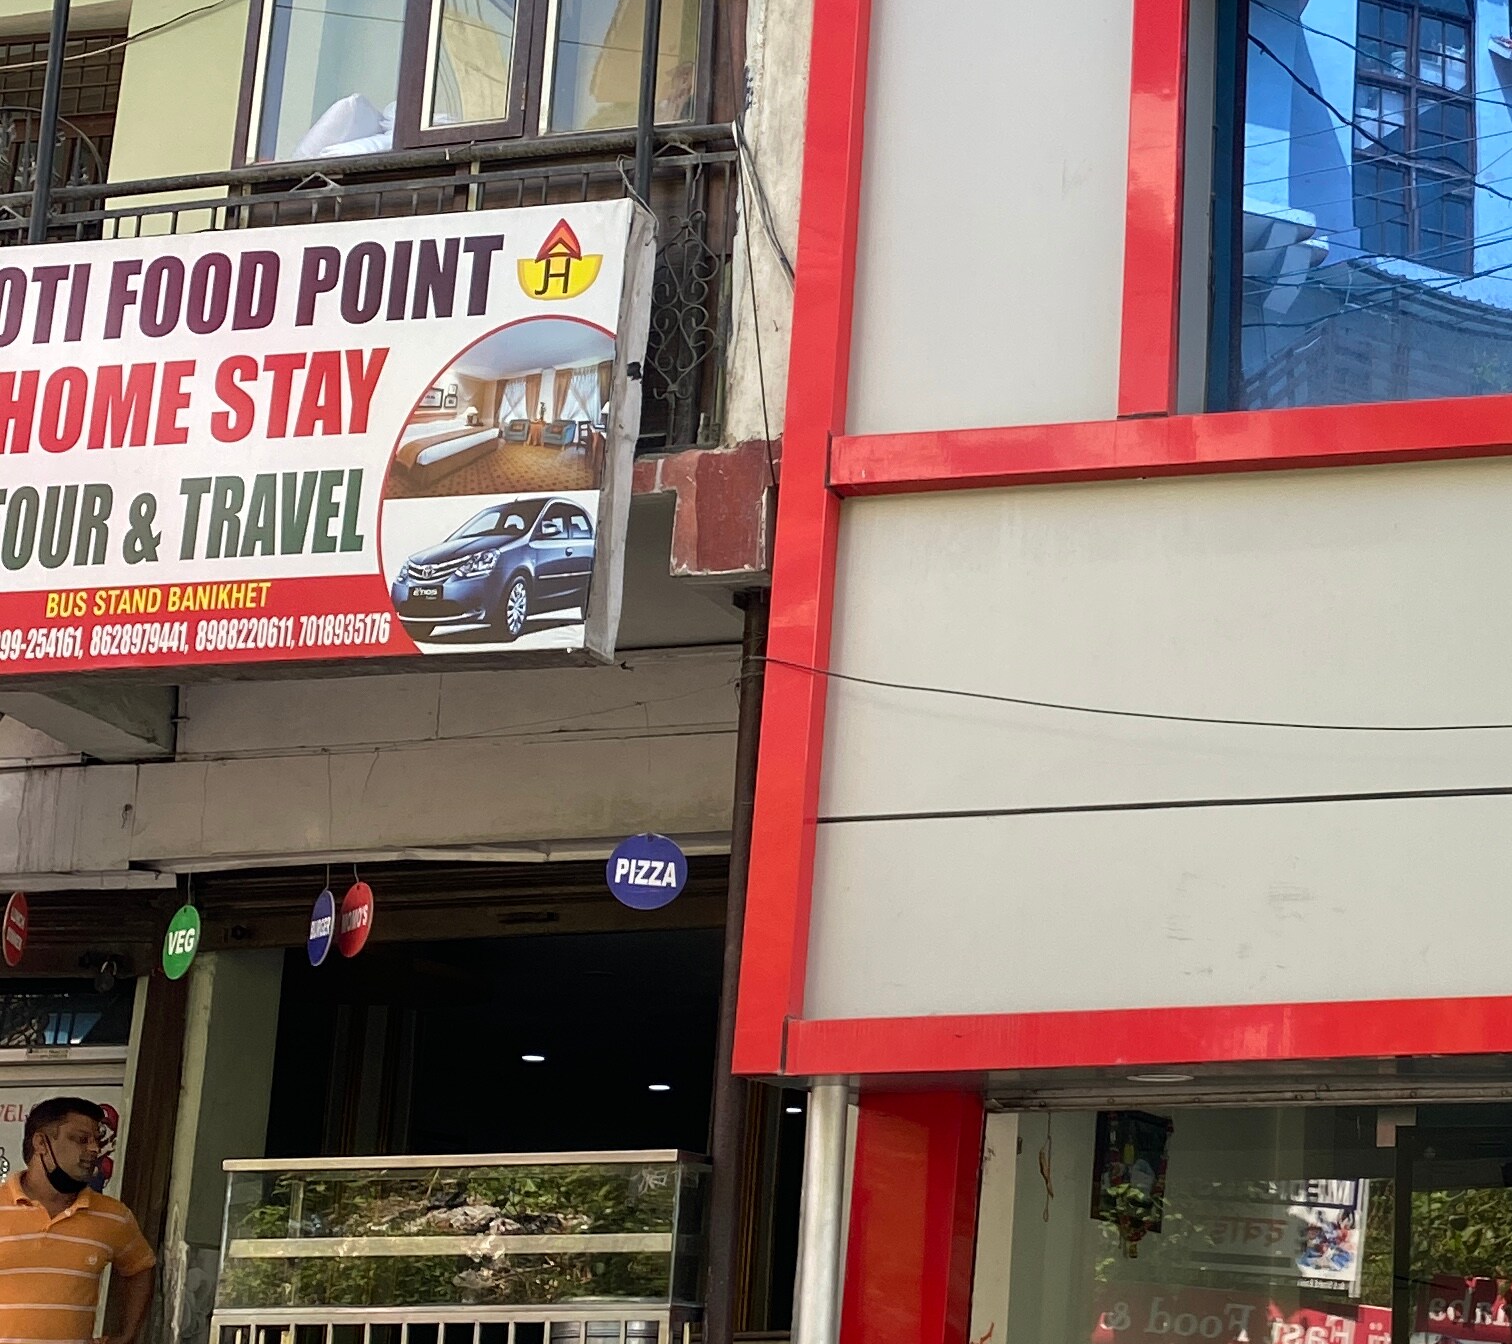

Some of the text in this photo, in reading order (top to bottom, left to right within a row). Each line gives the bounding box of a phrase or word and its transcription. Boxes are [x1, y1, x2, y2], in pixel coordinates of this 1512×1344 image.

[103, 250, 281, 340] FOOD
[295, 234, 504, 327] POINT
[0, 347, 390, 455] HOME STAY
[0, 467, 365, 571] OUR & TRAVEL
[46, 582, 271, 618] BUS STAND BANIKHET
[90, 620, 189, 657] 8628979441,
[195, 615, 295, 653] 8988220611,
[298, 611, 391, 648] 7018935176
[614, 858, 677, 887] PIZZA
[167, 928, 195, 955] VEG
